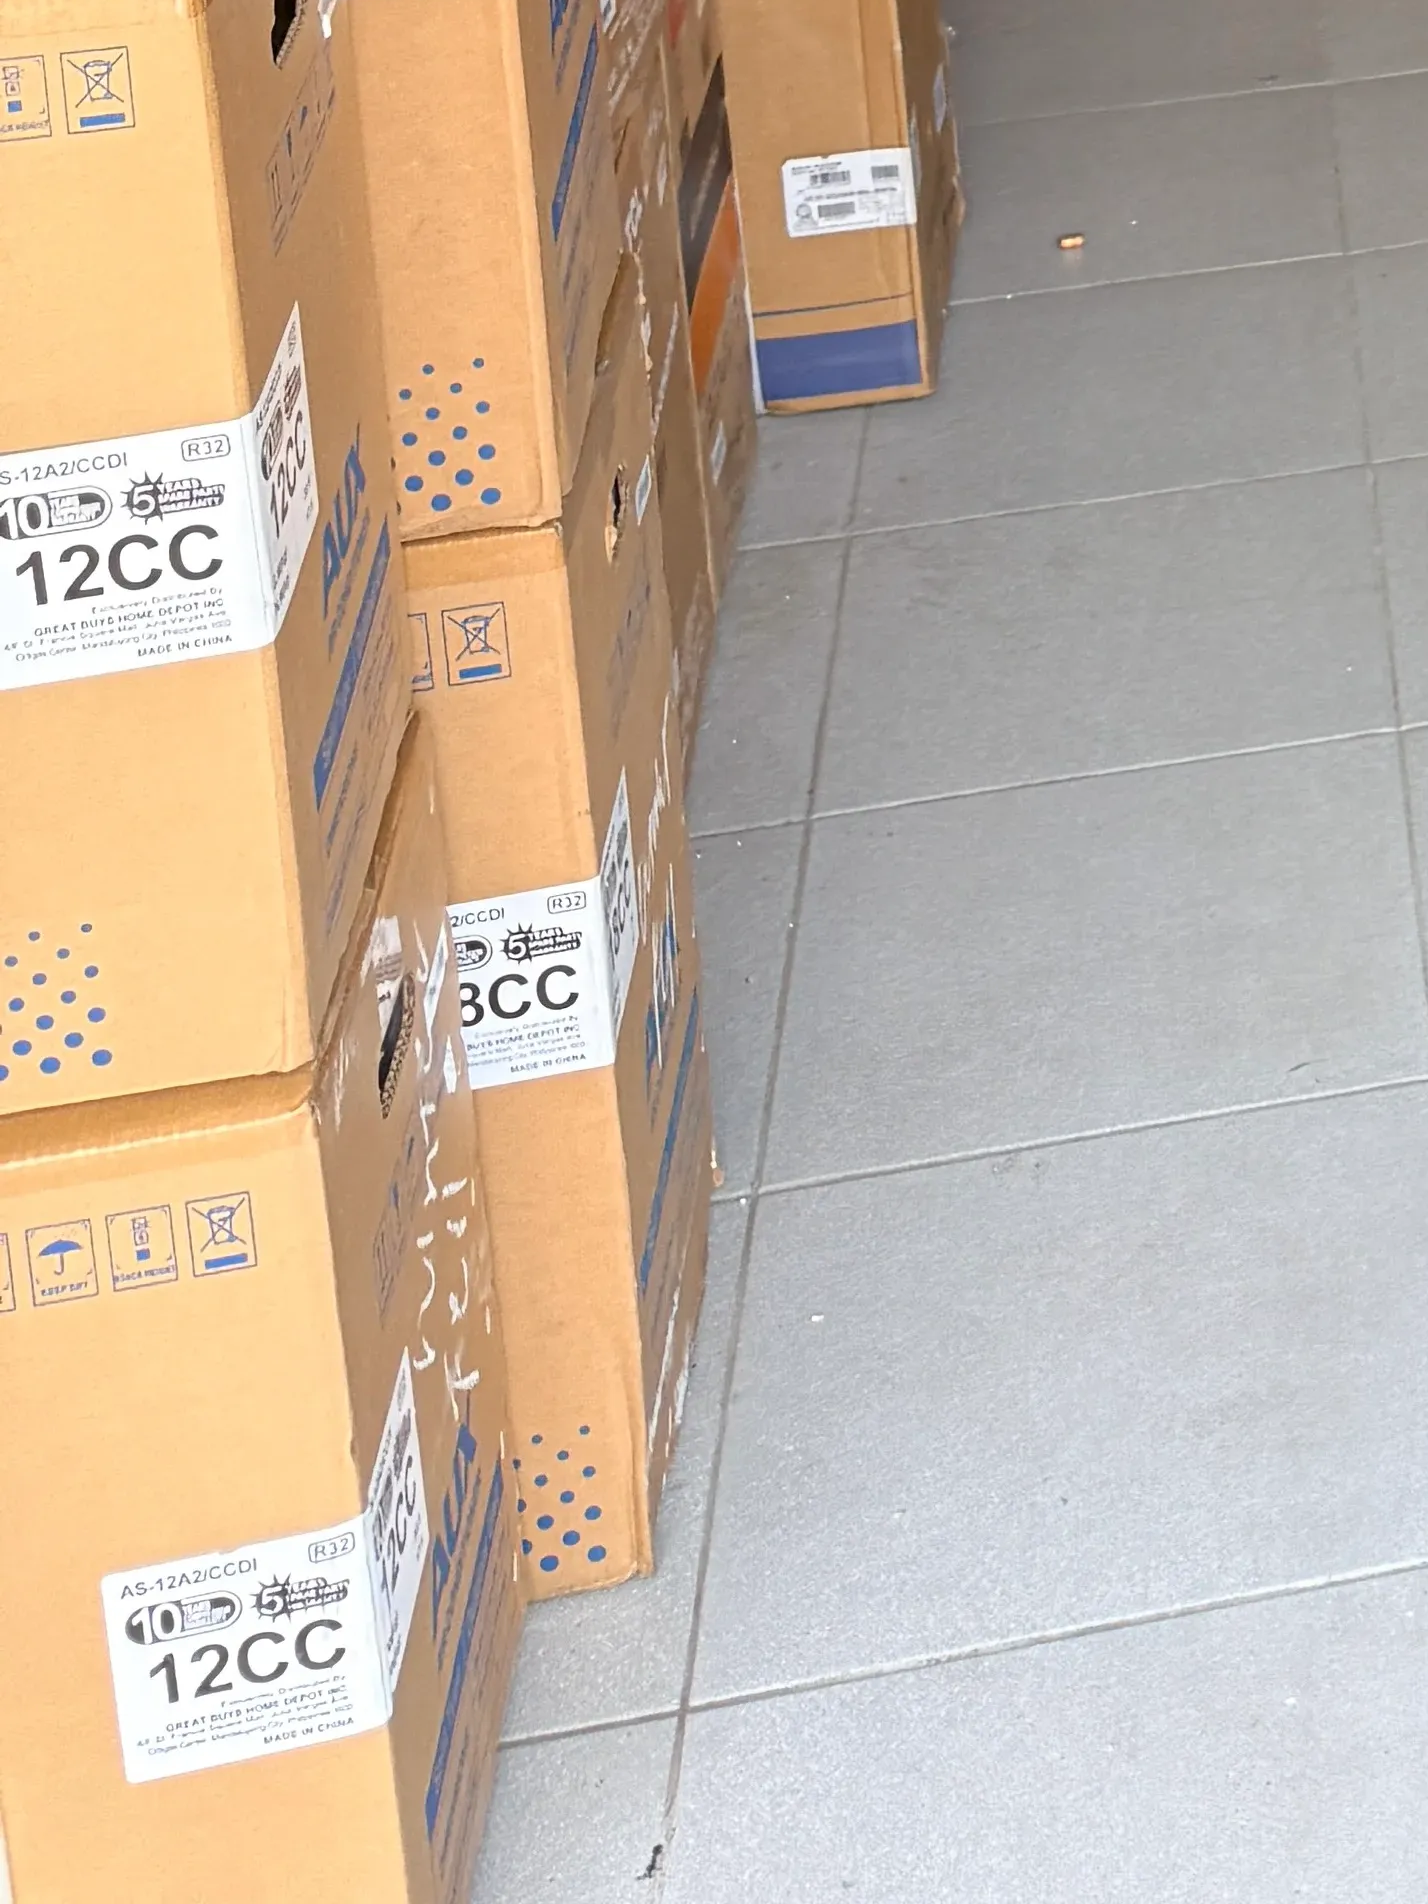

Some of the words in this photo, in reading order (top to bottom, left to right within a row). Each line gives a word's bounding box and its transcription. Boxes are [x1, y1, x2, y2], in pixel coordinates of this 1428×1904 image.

[187, 439, 225, 458] R32
[129, 483, 160, 517] 5
[15, 524, 223, 607] 12CC
[508, 933, 528, 958] 5
[120, 1558, 258, 1600] AS-12A2/CCDI
[313, 1538, 349, 1559] R32
[259, 1584, 288, 1617] 5
[130, 1602, 183, 1646] 10
[150, 1619, 346, 1704] 12CC
